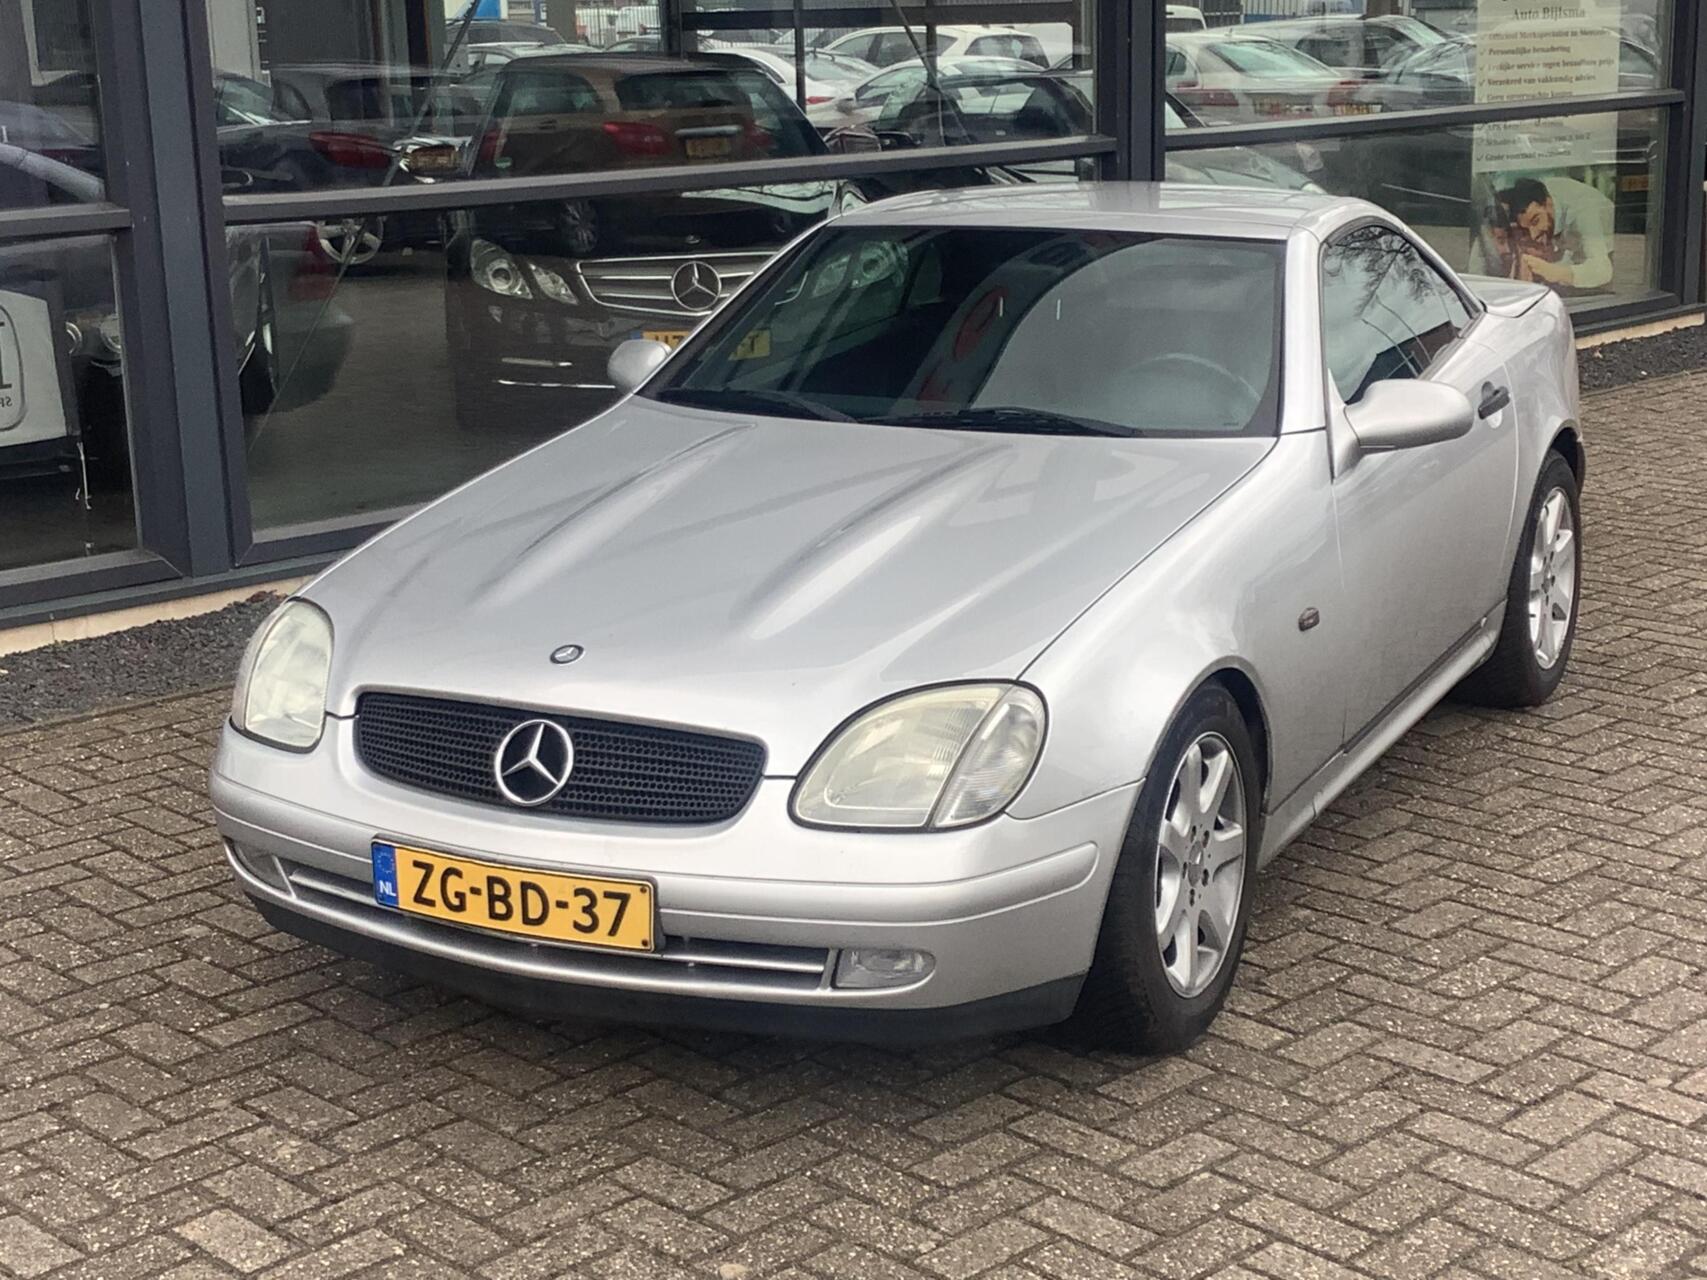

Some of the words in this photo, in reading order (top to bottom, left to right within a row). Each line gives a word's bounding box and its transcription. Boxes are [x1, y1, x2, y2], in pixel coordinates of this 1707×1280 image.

[1513, 8, 1539, 20] Auto
[379, 880, 396, 897] NL
[412, 860, 631, 937] ZG-BD-37
